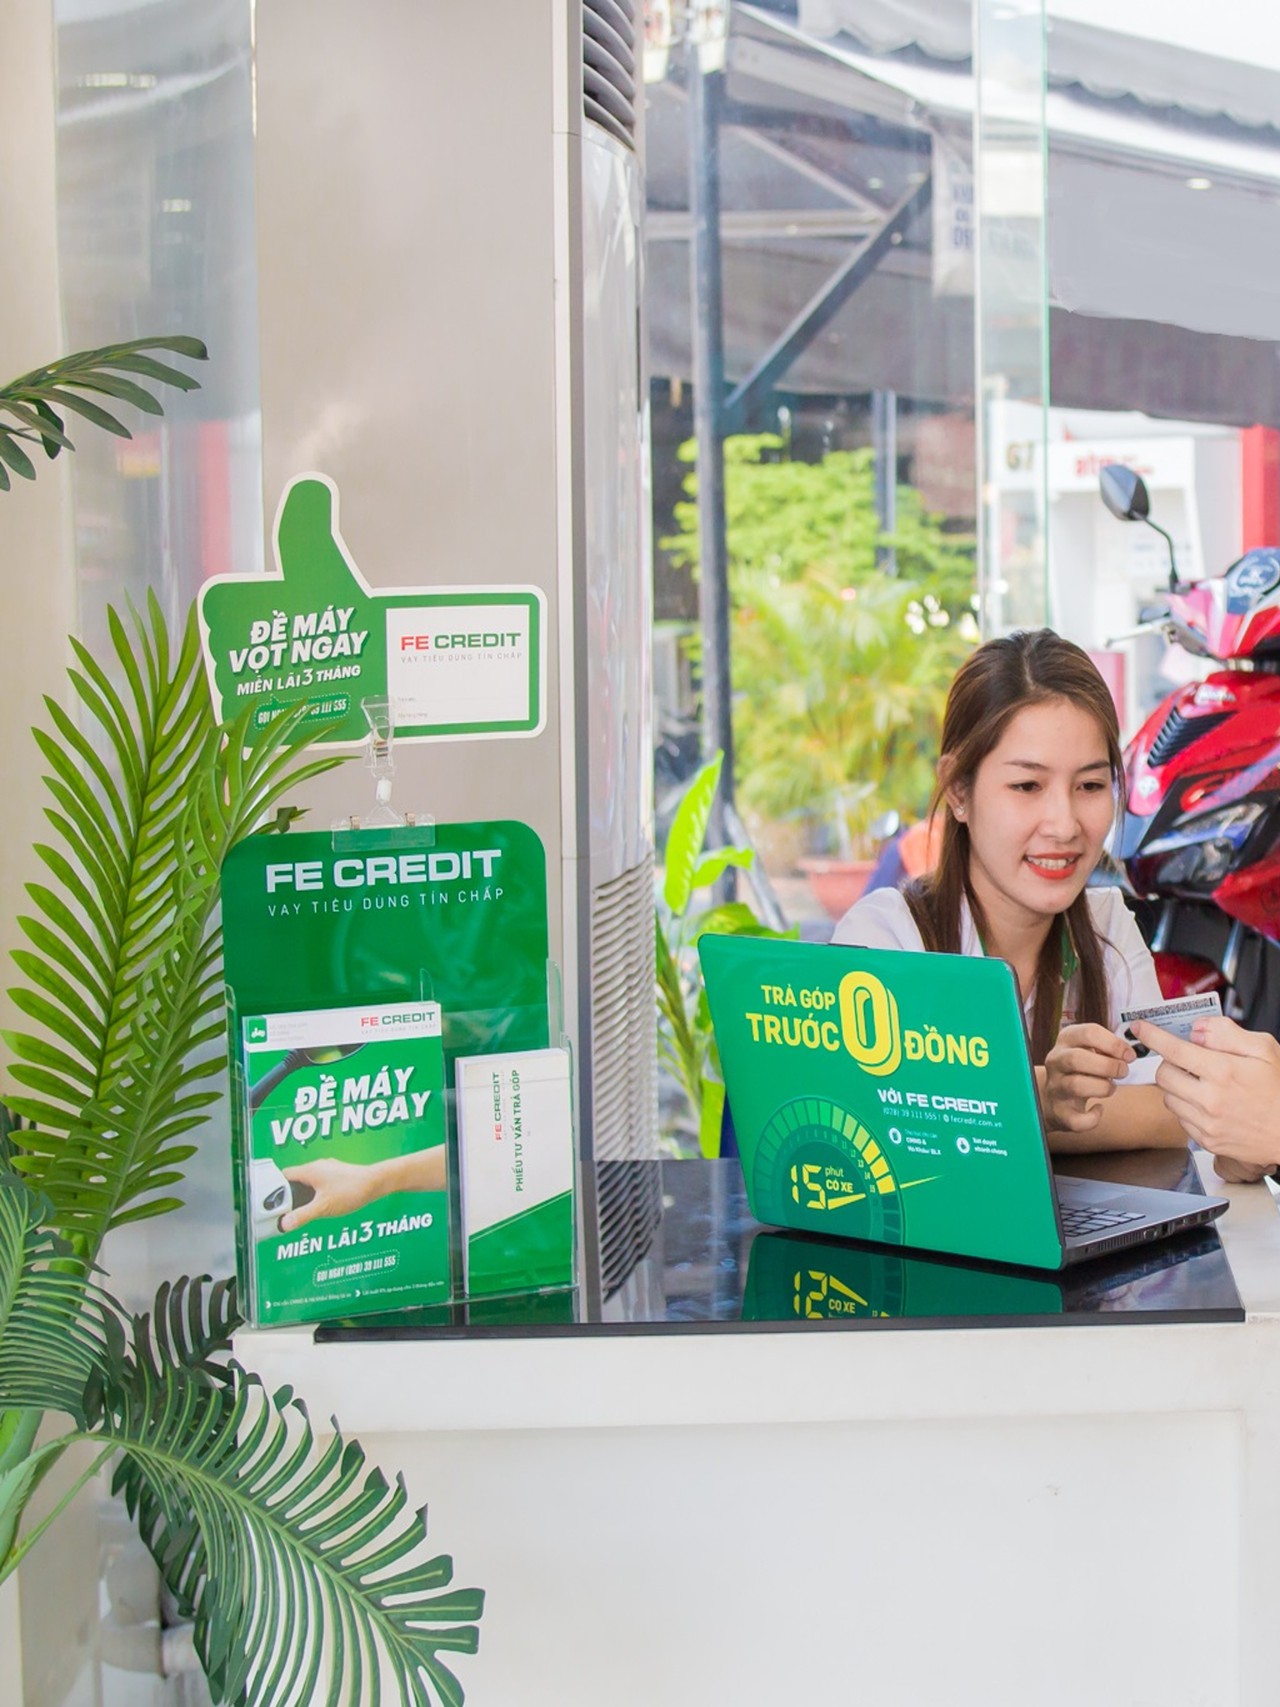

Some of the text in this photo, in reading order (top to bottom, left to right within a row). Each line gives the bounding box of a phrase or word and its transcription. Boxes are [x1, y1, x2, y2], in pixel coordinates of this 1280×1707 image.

[250, 605, 355, 645] ĐỀ MÁY
[401, 633, 521, 651] FE CREDIT
[229, 630, 368, 674] VỌT NGAY
[237, 665, 361, 696] MIỄN LÃI 3 THÁNG
[266, 849, 502, 893] FE CREDIT
[268, 885, 504, 917] VAY TIÊU DÙNG TÍN CHẤP
[761, 984, 836, 1011] TRẢ GÓP
[361, 1011, 435, 1027] FE CREDIT
[745, 970, 990, 1077] TRƯỚC 0 ĐỒNG
[295, 1065, 415, 1113] ĐỀ MÁY
[493, 1072, 502, 1140] FE CREDIT
[877, 1087, 998, 1116] VỚI FE CREDIT
[271, 1090, 432, 1145] VỌT NGAY
[512, 1160, 523, 1192] PHIẾU
[791, 1164, 826, 1210] 15
[840, 1181, 854, 1193] XE
[277, 1213, 433, 1261] MIỄN LÃI 3 THÁNG
